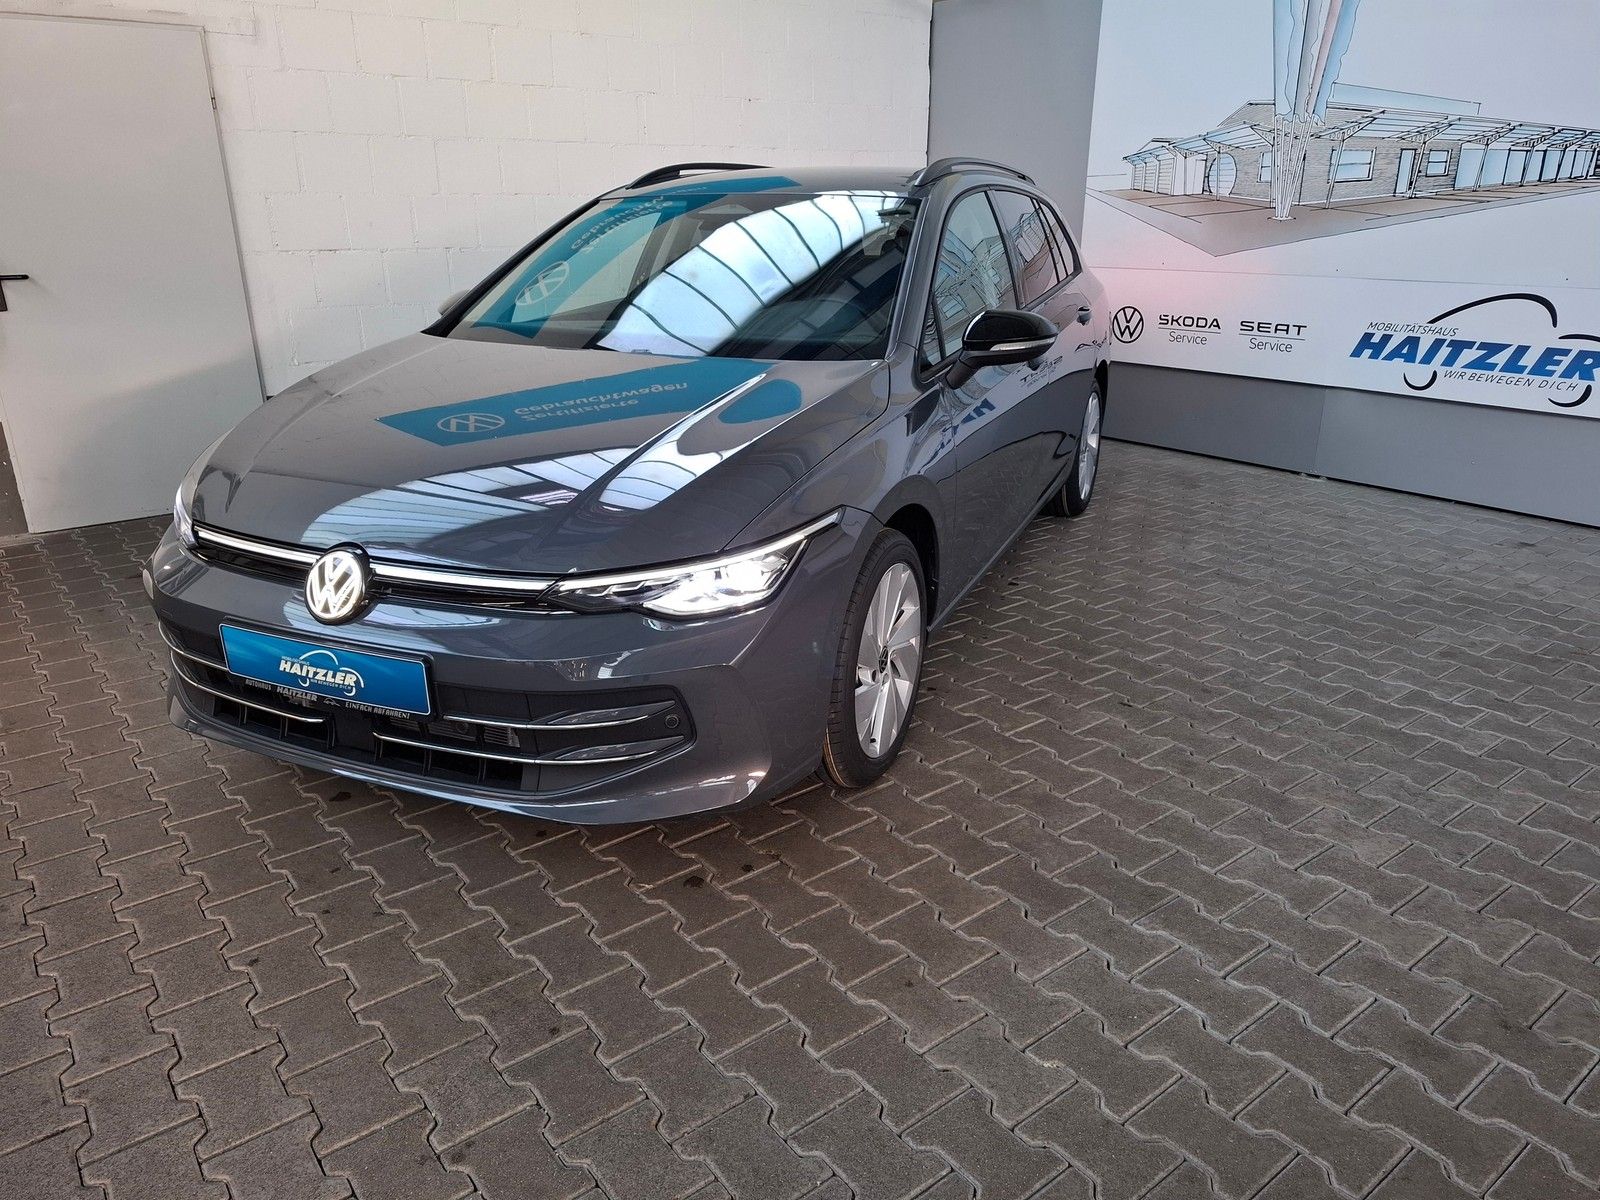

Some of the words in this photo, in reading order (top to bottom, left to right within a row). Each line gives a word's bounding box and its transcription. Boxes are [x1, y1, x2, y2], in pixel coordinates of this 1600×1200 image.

[1239, 320, 1307, 336] SEAT
[1367, 321, 1459, 337] MOBILITÄTSHAUS
[1168, 331, 1208, 346] Service
[1249, 337, 1293, 353] Service
[1349, 331, 1600, 381] HAITZLER
[1443, 369, 1465, 380] WIR
[1468, 372, 1538, 388] BEWEGEN
[1538, 379, 1579, 392] DICH
[279, 659, 358, 687] HAITZLER
[245, 678, 272, 691] AUTOHAUS
[277, 686, 318, 702] HAITZLER
[345, 702, 373, 713] EINFACH
